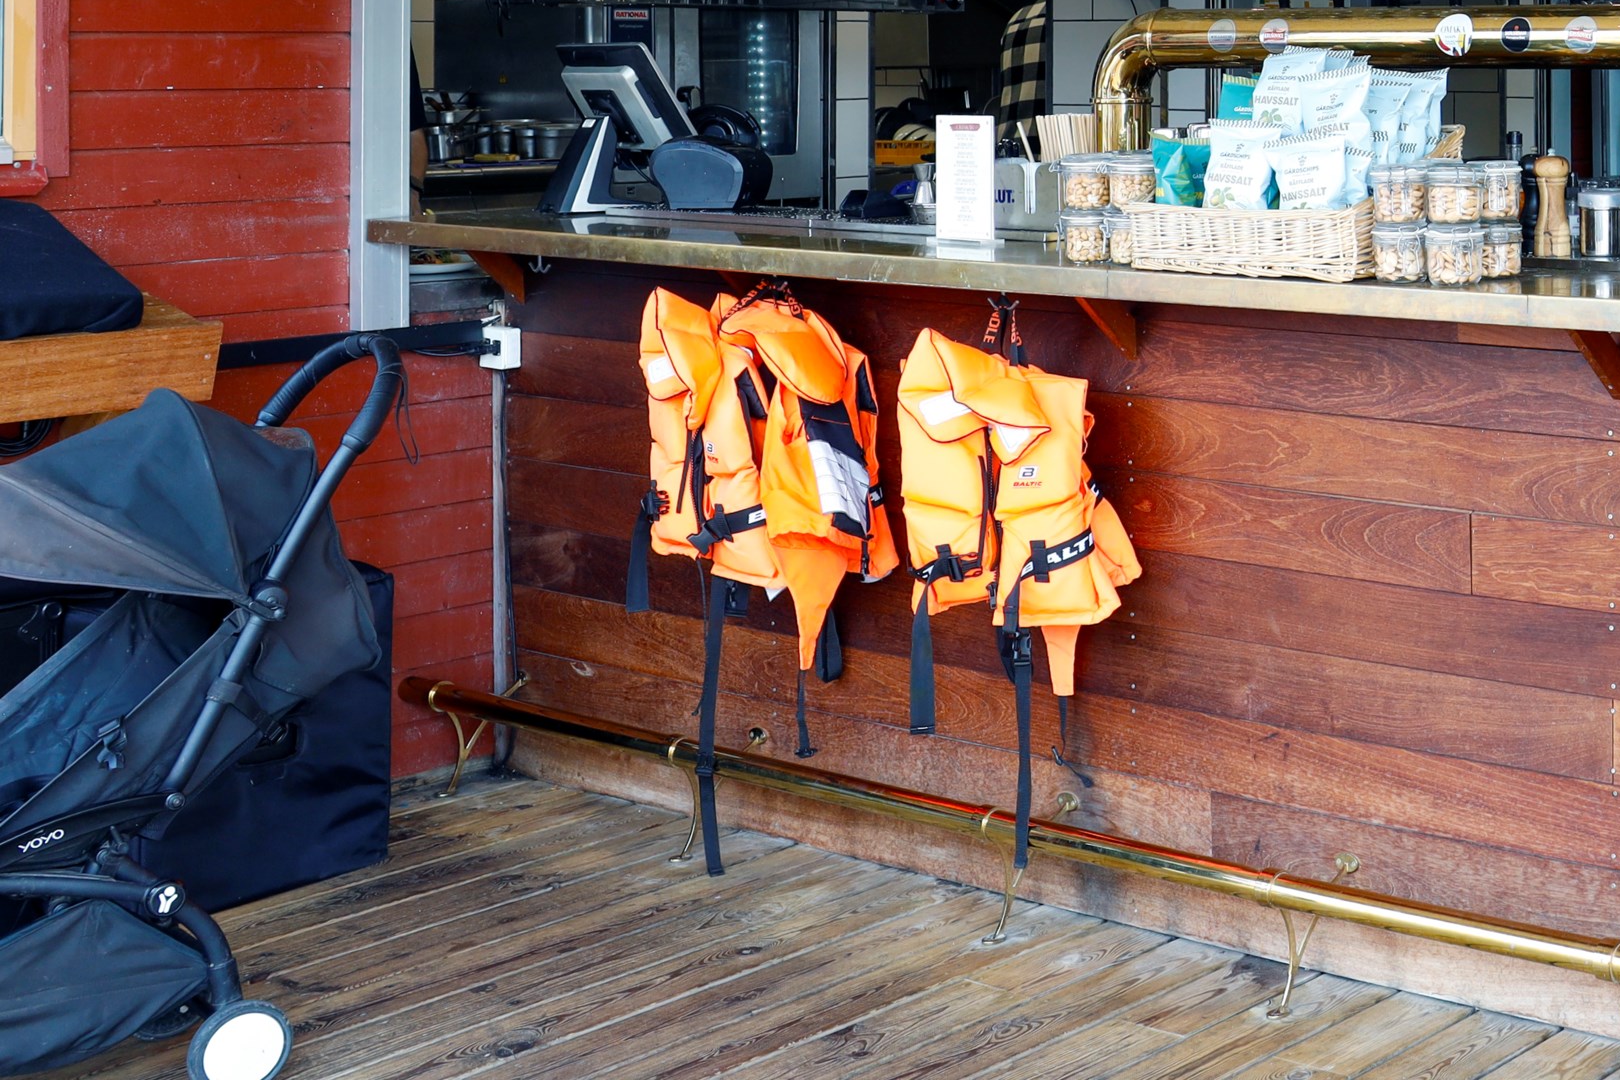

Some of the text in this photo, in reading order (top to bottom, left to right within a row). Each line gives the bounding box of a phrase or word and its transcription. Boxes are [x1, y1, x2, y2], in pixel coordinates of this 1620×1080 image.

[1254, 96, 1299, 106] HAVSSALT
[1207, 173, 1253, 186] HAVSSALT
[1281, 187, 1327, 203] HAVSSALT
